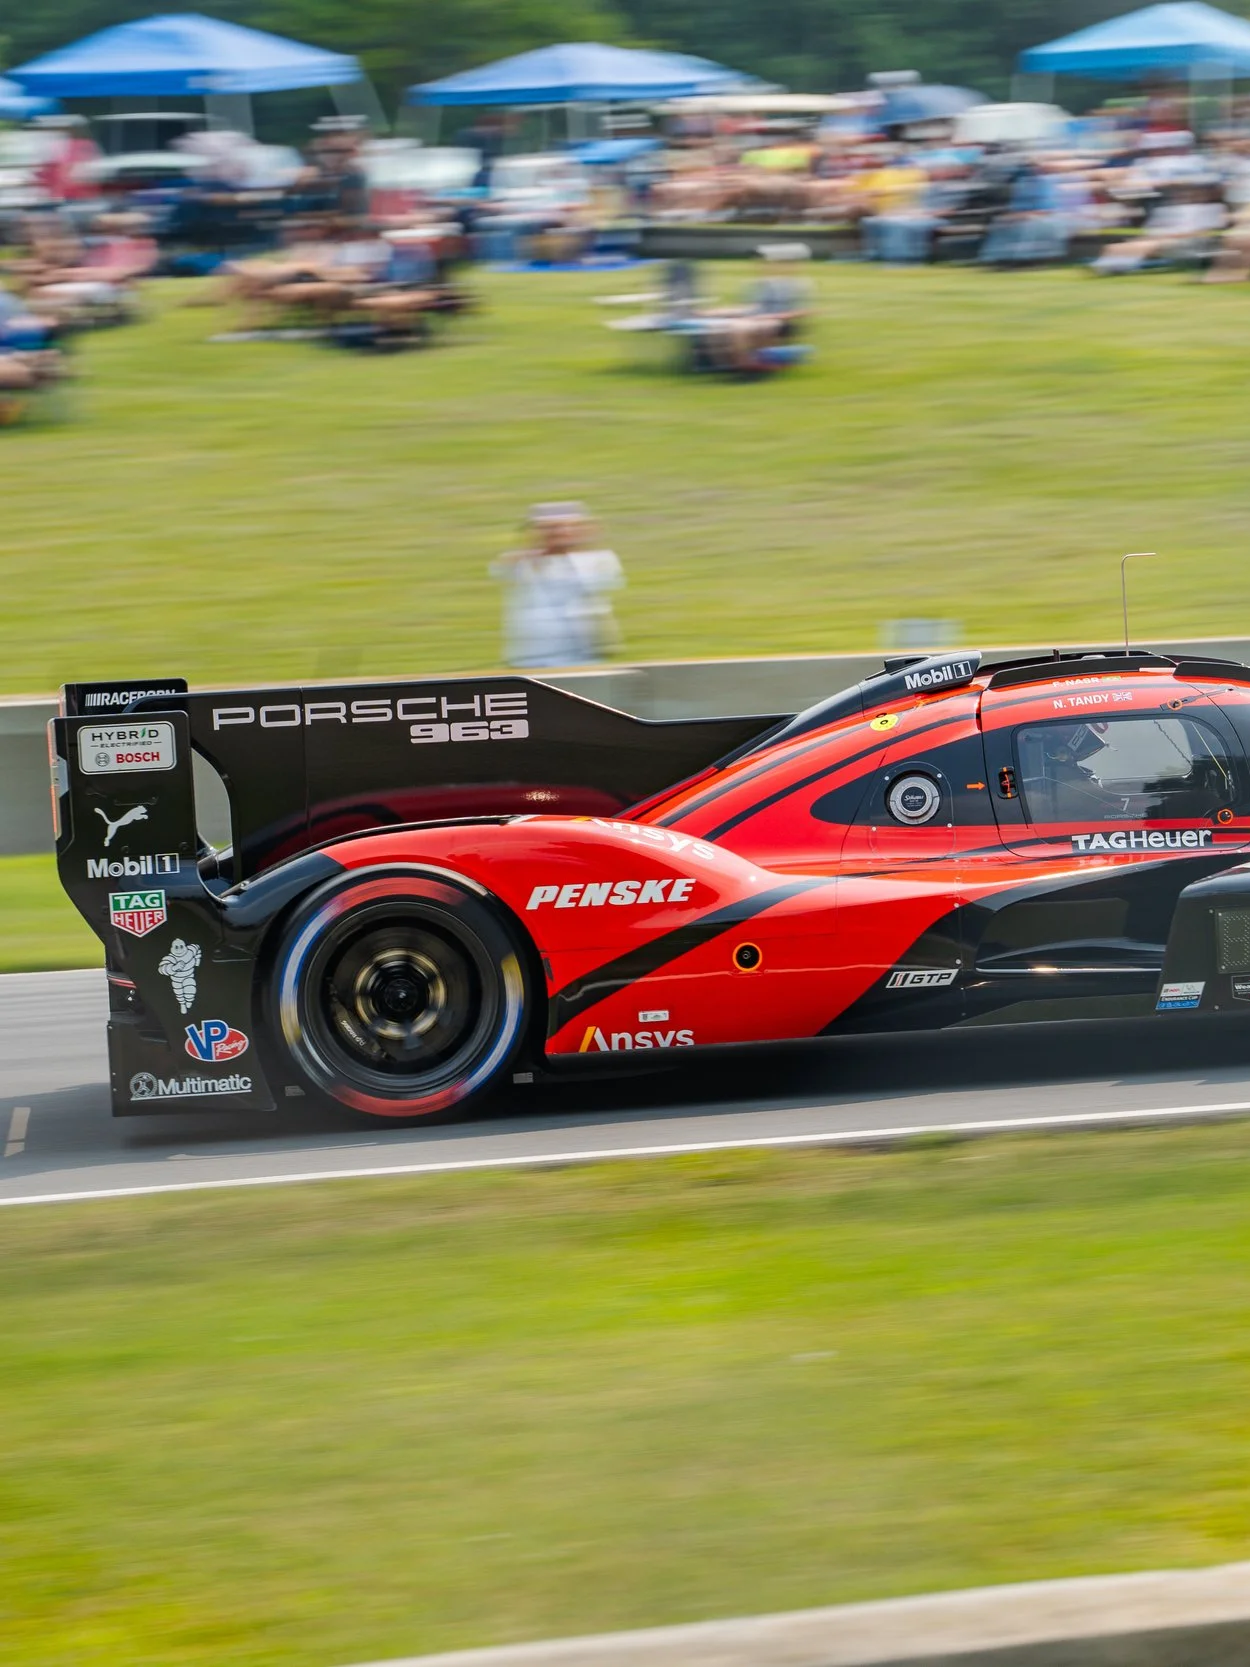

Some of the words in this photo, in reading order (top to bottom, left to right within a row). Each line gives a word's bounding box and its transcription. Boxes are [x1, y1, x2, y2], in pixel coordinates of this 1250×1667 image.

[904, 665, 953, 690] Mobil
[212, 692, 528, 731] PORSCHE
[1053, 698, 1067, 710] N.
[1067, 693, 1109, 707] TANDY
[91, 727, 159, 741] HYBRID
[410, 718, 529, 744] 963
[100, 740, 153, 748] ELECTRIFIED
[116, 751, 160, 764] BOSCH
[1120, 797, 1130, 812] 7
[86, 855, 153, 879] Mobil
[113, 893, 161, 910] TAG
[525, 878, 697, 911] PENSKE
[114, 910, 164, 934] HEUER
[909, 972, 953, 985] GTP
[185, 1019, 229, 1061] VP
[158, 1074, 252, 1096] Multimatic
